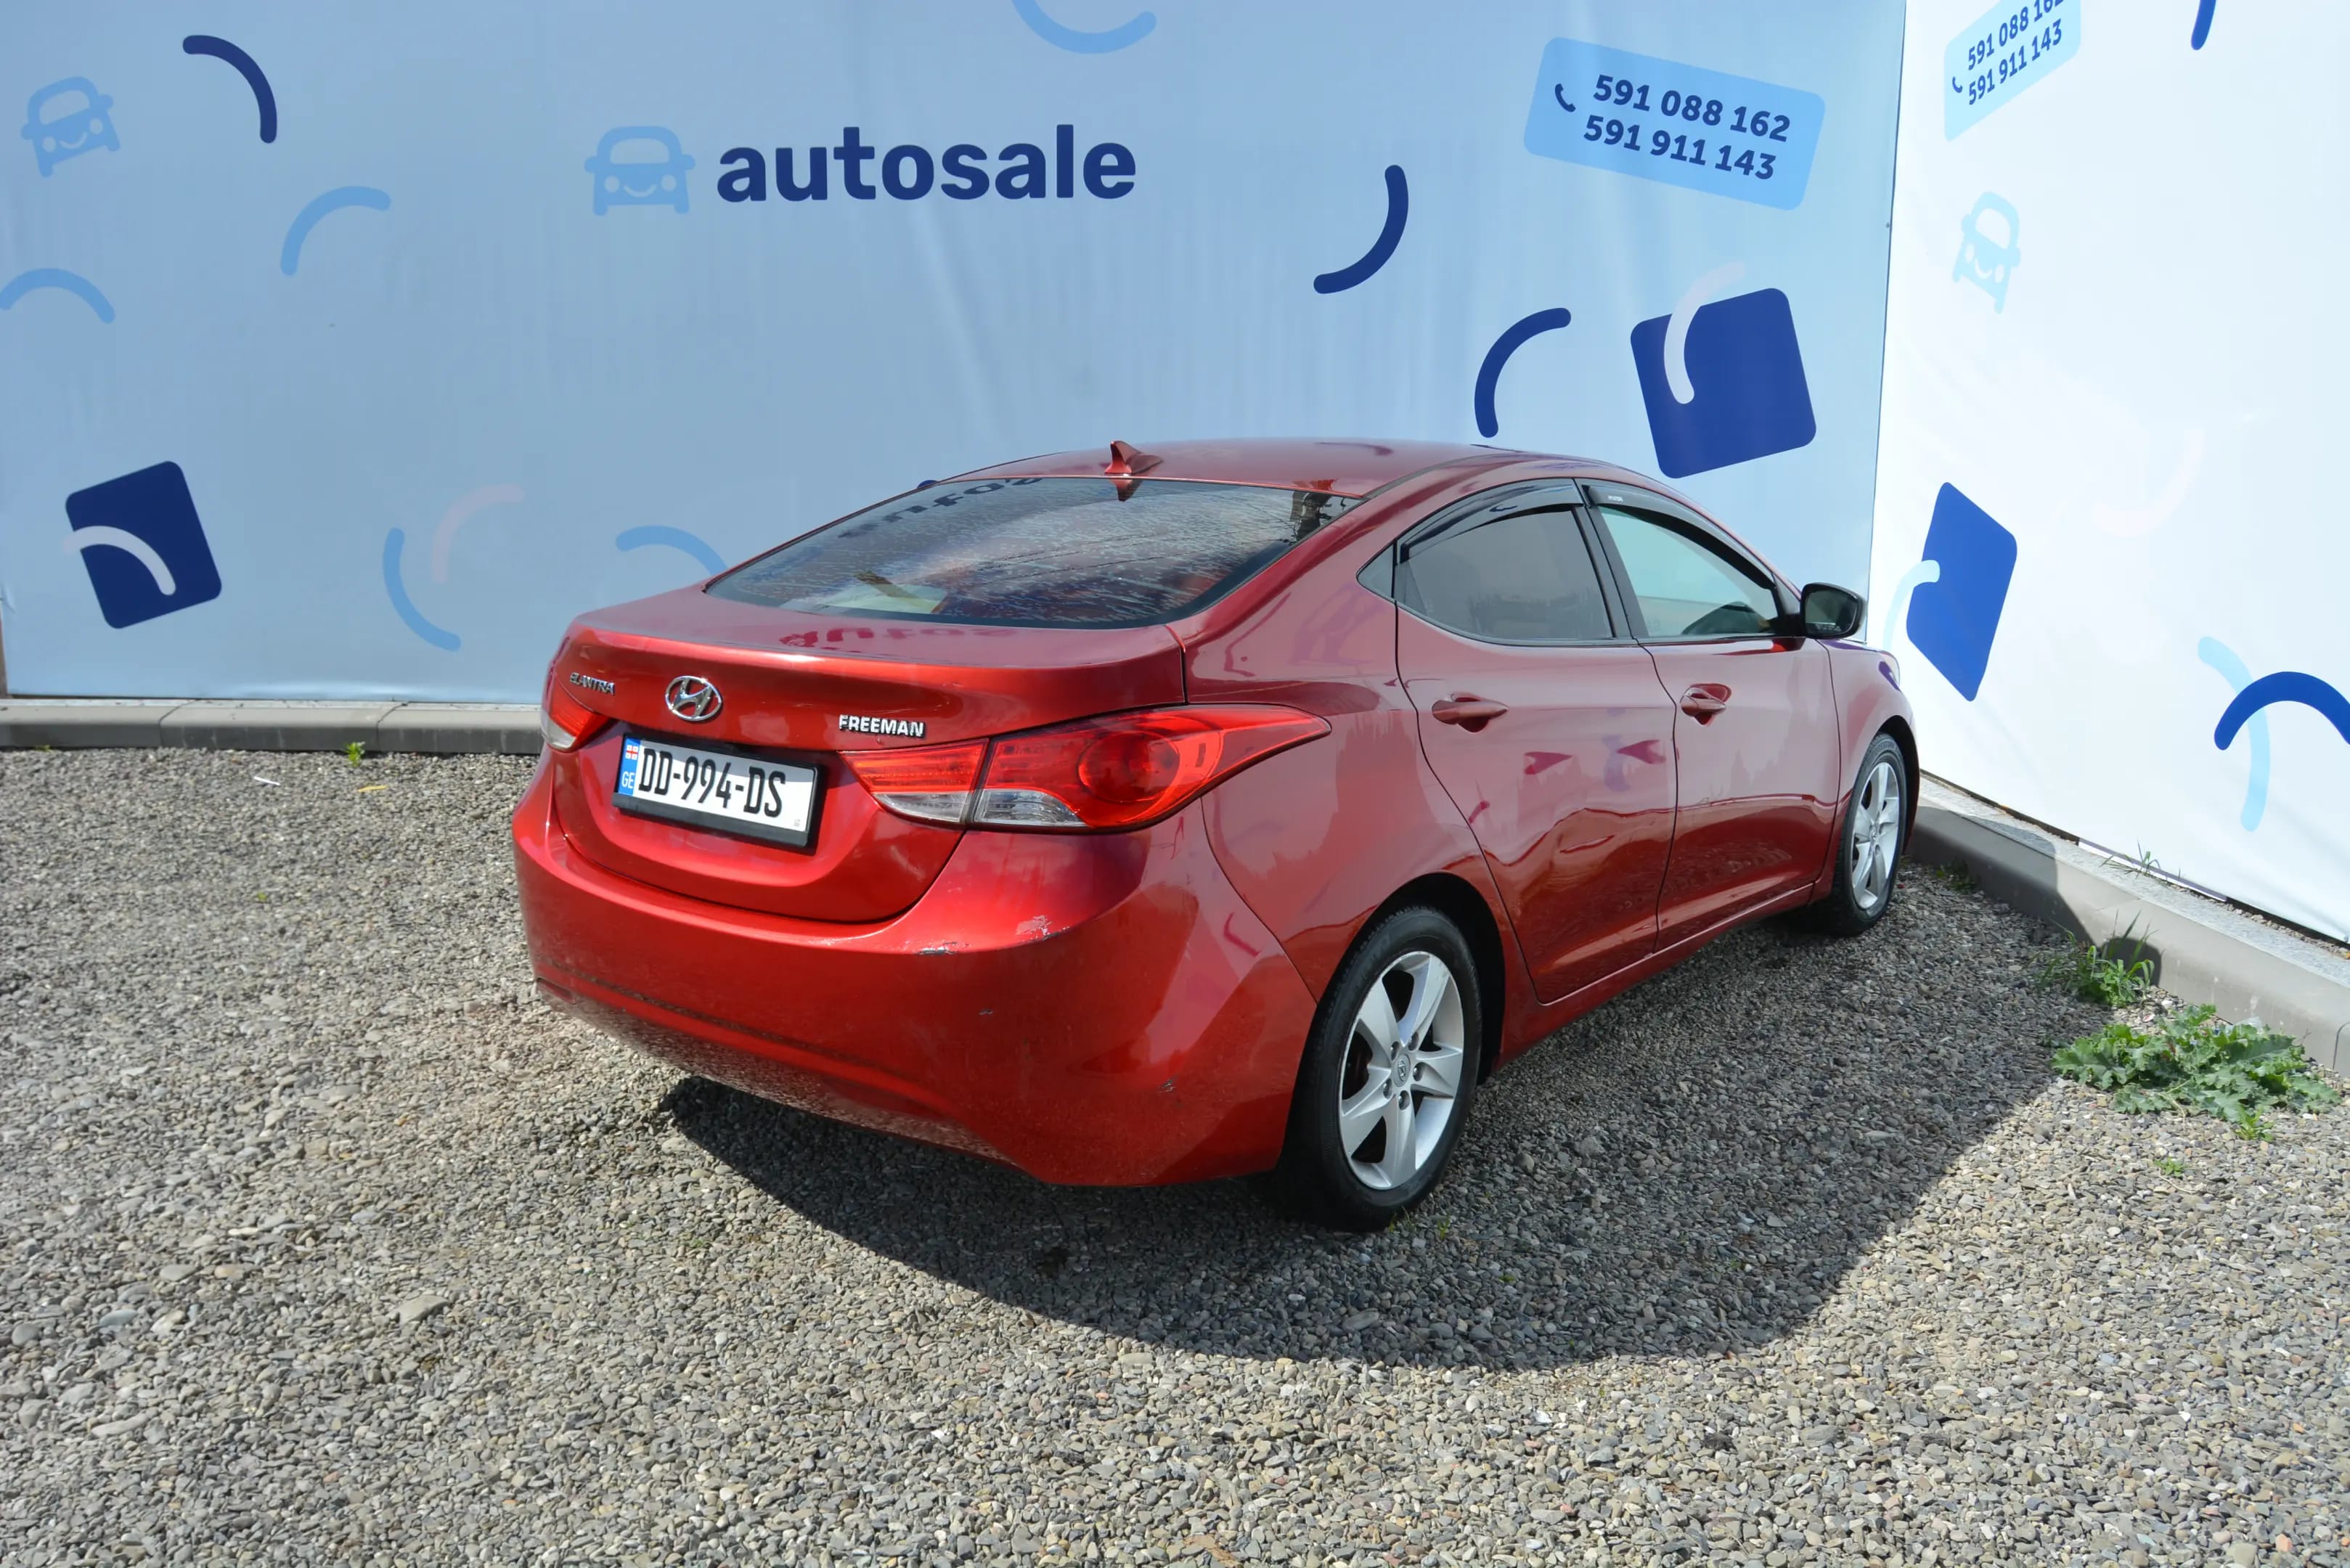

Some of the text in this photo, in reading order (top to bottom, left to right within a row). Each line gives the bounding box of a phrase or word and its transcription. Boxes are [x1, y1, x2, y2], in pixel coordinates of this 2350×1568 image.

[1968, 0, 2063, 70] 591 088 16
[1969, 18, 2062, 105] 591 911 143
[1593, 74, 1790, 142] 591 088 162
[717, 124, 1136, 203] autosale
[1583, 114, 1776, 180] 591 911 143
[569, 671, 616, 695] ELANTRA
[839, 714, 925, 738] FREEMAN
[621, 771, 635, 789] GE
[638, 748, 786, 818] DD-994-DS
